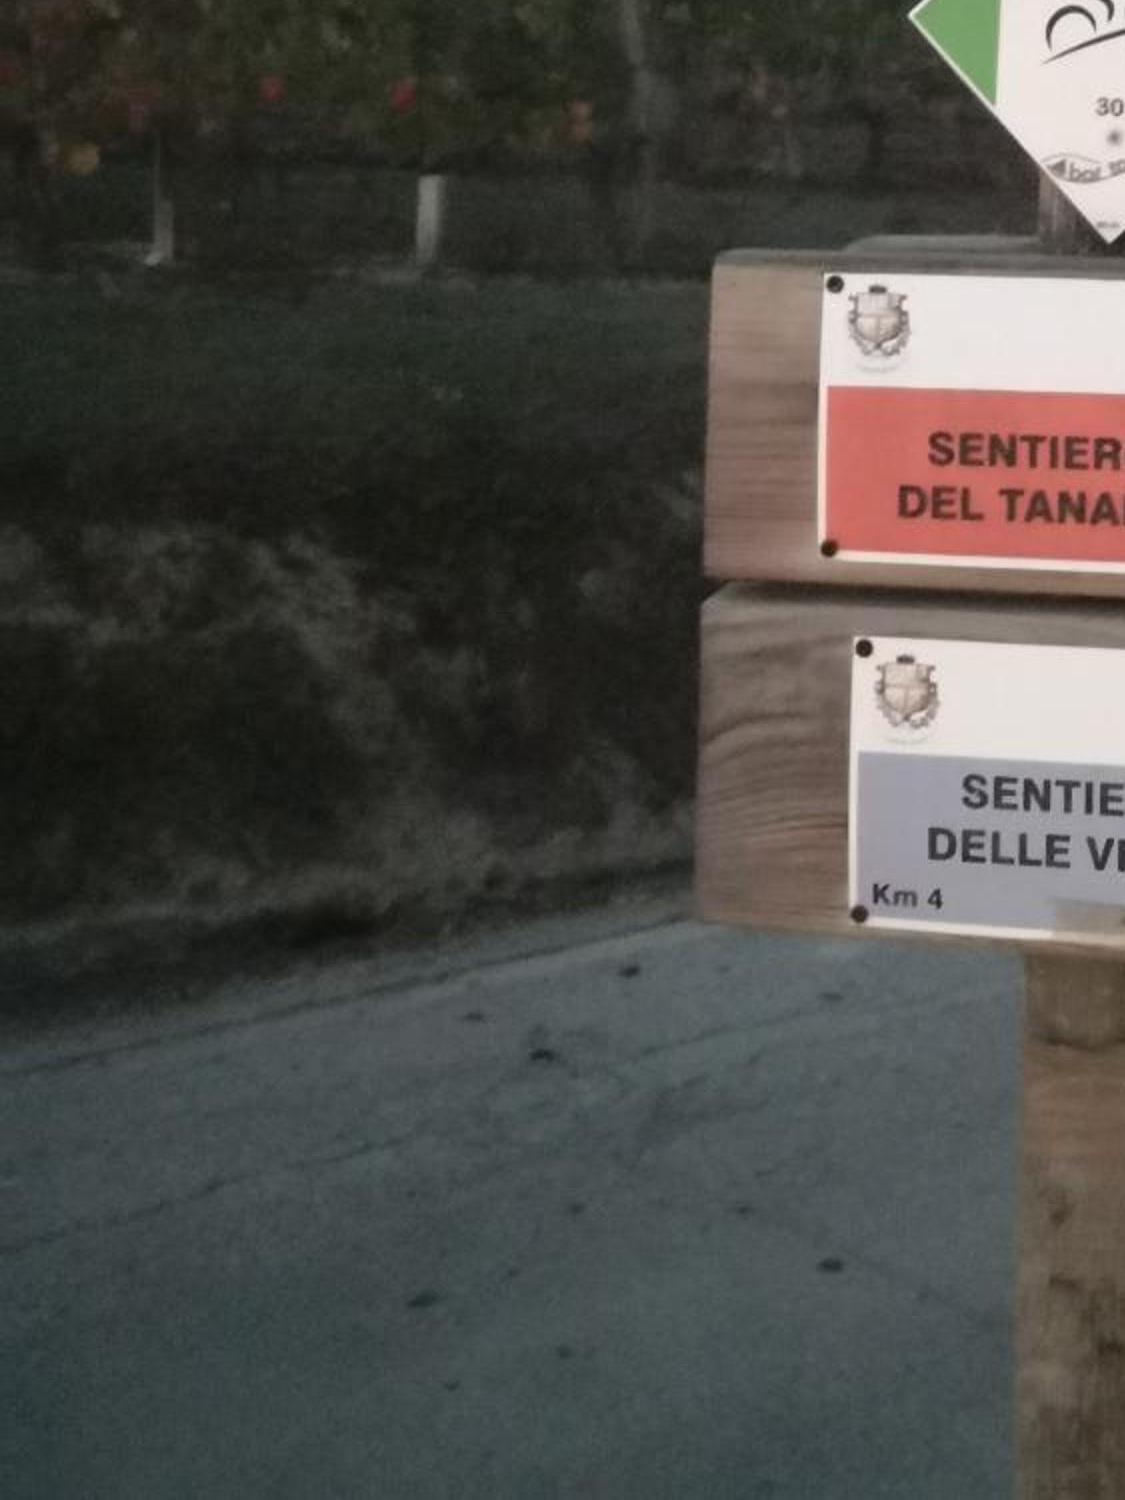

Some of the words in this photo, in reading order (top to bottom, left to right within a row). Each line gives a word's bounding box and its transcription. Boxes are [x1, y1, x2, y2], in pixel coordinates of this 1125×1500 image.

[897, 484, 985, 522] DEL
[927, 826, 1071, 869] DELLE
[872, 883, 918, 908] Km
[927, 888, 943, 910] 4
